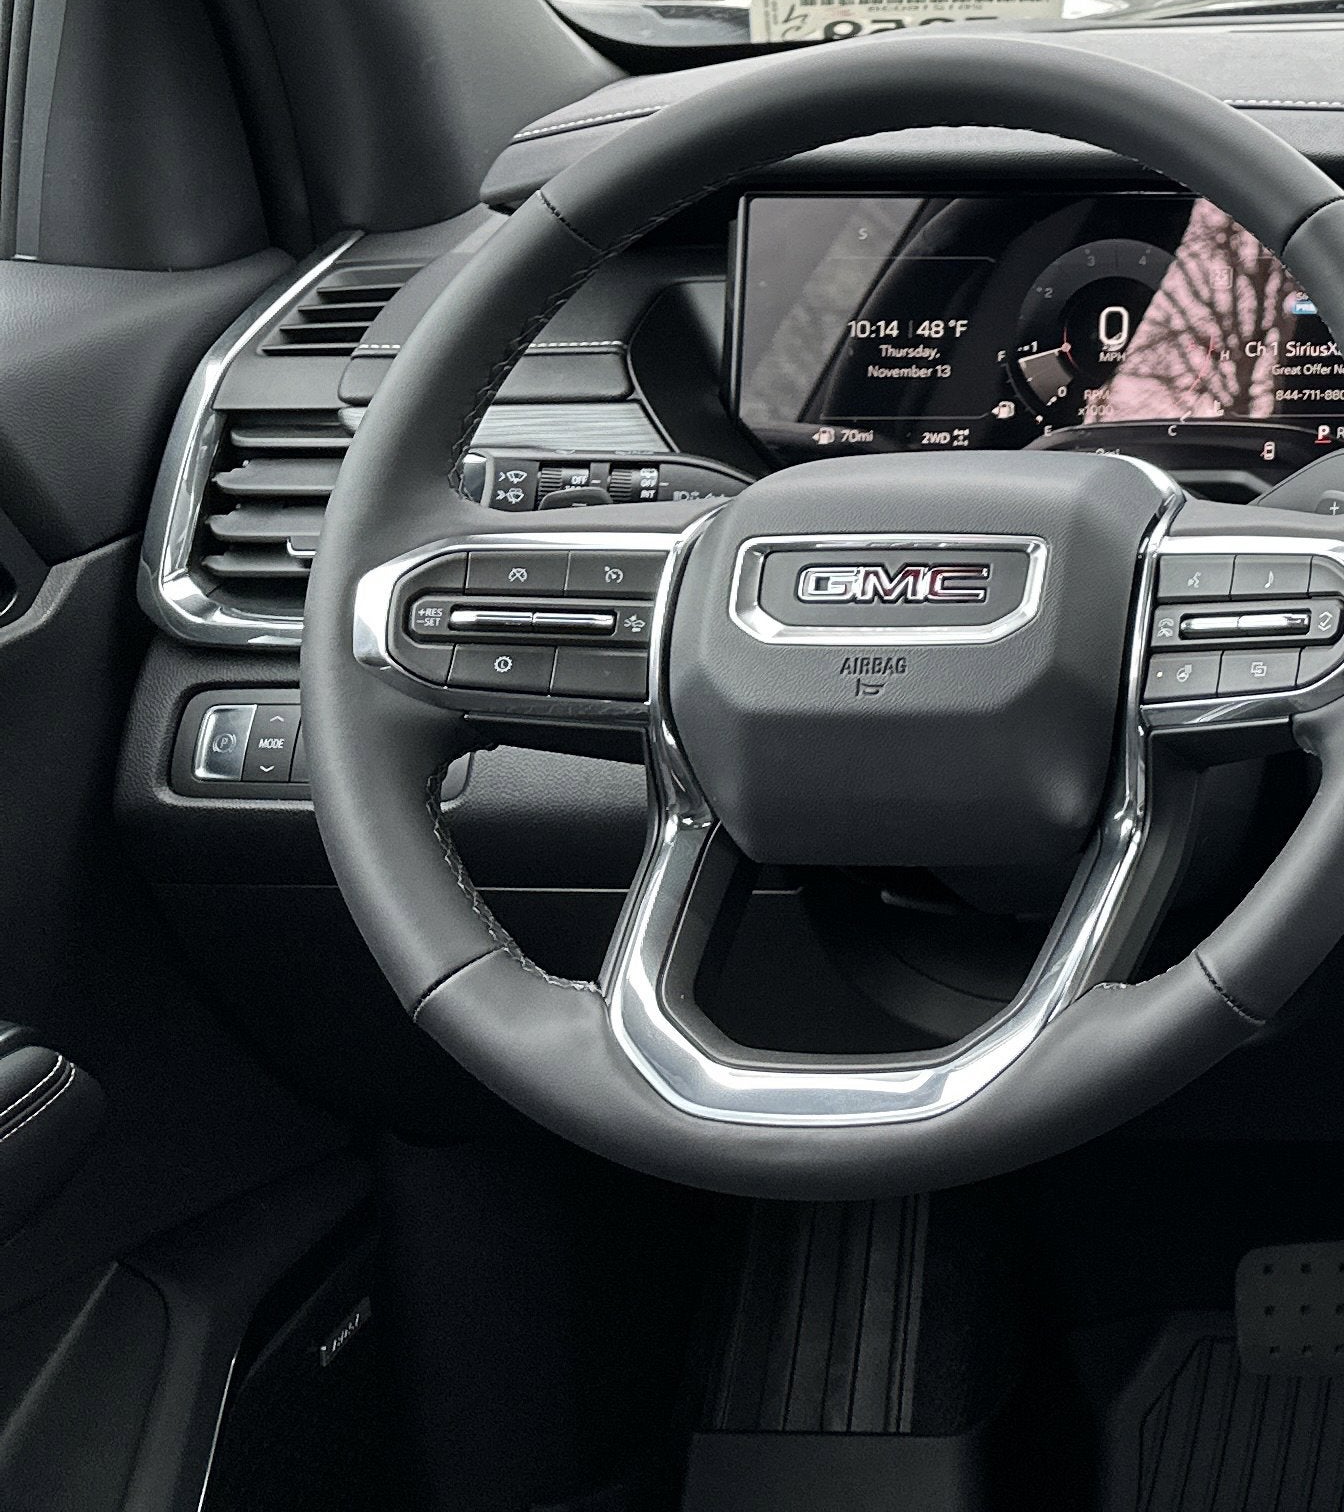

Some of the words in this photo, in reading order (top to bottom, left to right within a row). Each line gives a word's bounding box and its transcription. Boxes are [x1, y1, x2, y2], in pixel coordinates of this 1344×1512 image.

[858, 228, 868, 240] S
[1044, 287, 1053, 299] 2
[848, 320, 899, 338] 10:14
[1099, 306, 1130, 346] 0
[879, 345, 941, 360] Thursday,
[1220, 351, 1230, 361] H
[1245, 342, 1265, 357] Ch
[1272, 342, 1279, 356] 1
[1285, 342, 1342, 357] SiriusX
[1099, 351, 1126, 363] MPH
[867, 364, 931, 378] November
[934, 364, 951, 378] 13
[1272, 364, 1301, 376] Great
[1303, 363, 1332, 376] Offer
[1083, 389, 1111, 401] RPM
[841, 429, 874, 443] 70mi
[1044, 425, 1053, 436] E
[1167, 425, 1178, 437] C
[1318, 424, 1331, 440] P
[921, 431, 950, 444] 2WD
[571, 475, 588, 485] OFF
[798, 564, 992, 604] GMC
[840, 656, 907, 676] AIRBAG
[258, 736, 285, 750] MODE
